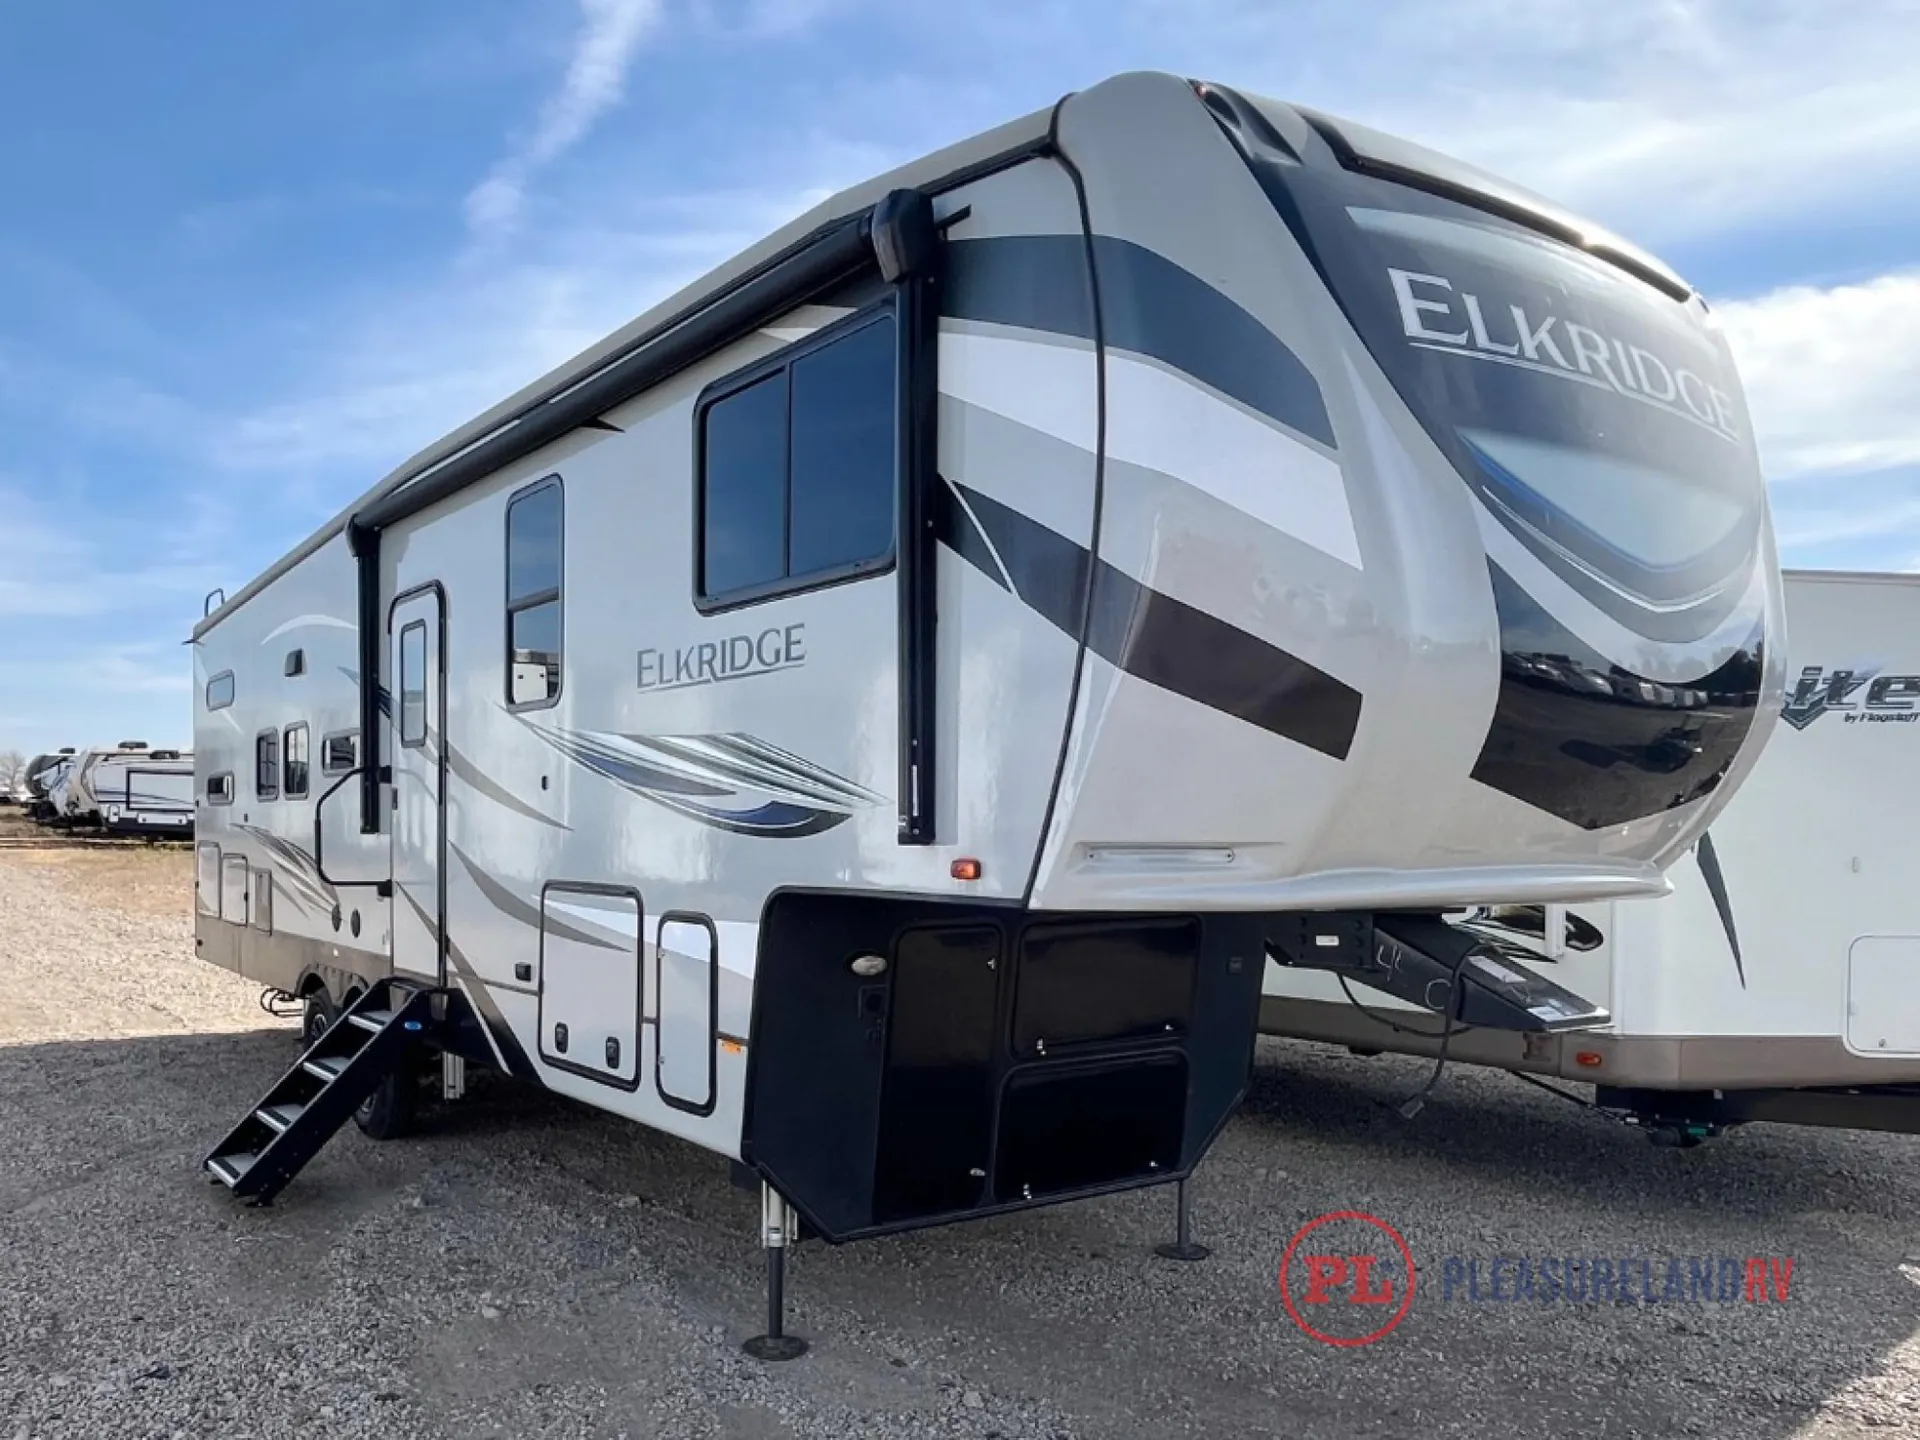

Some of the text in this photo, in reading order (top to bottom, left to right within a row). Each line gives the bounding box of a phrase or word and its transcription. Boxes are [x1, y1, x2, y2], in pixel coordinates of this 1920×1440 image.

[1387, 267, 1740, 438] ELKRIDGE
[637, 622, 806, 689] ELKRIDGE
[1845, 712, 1858, 724] by
